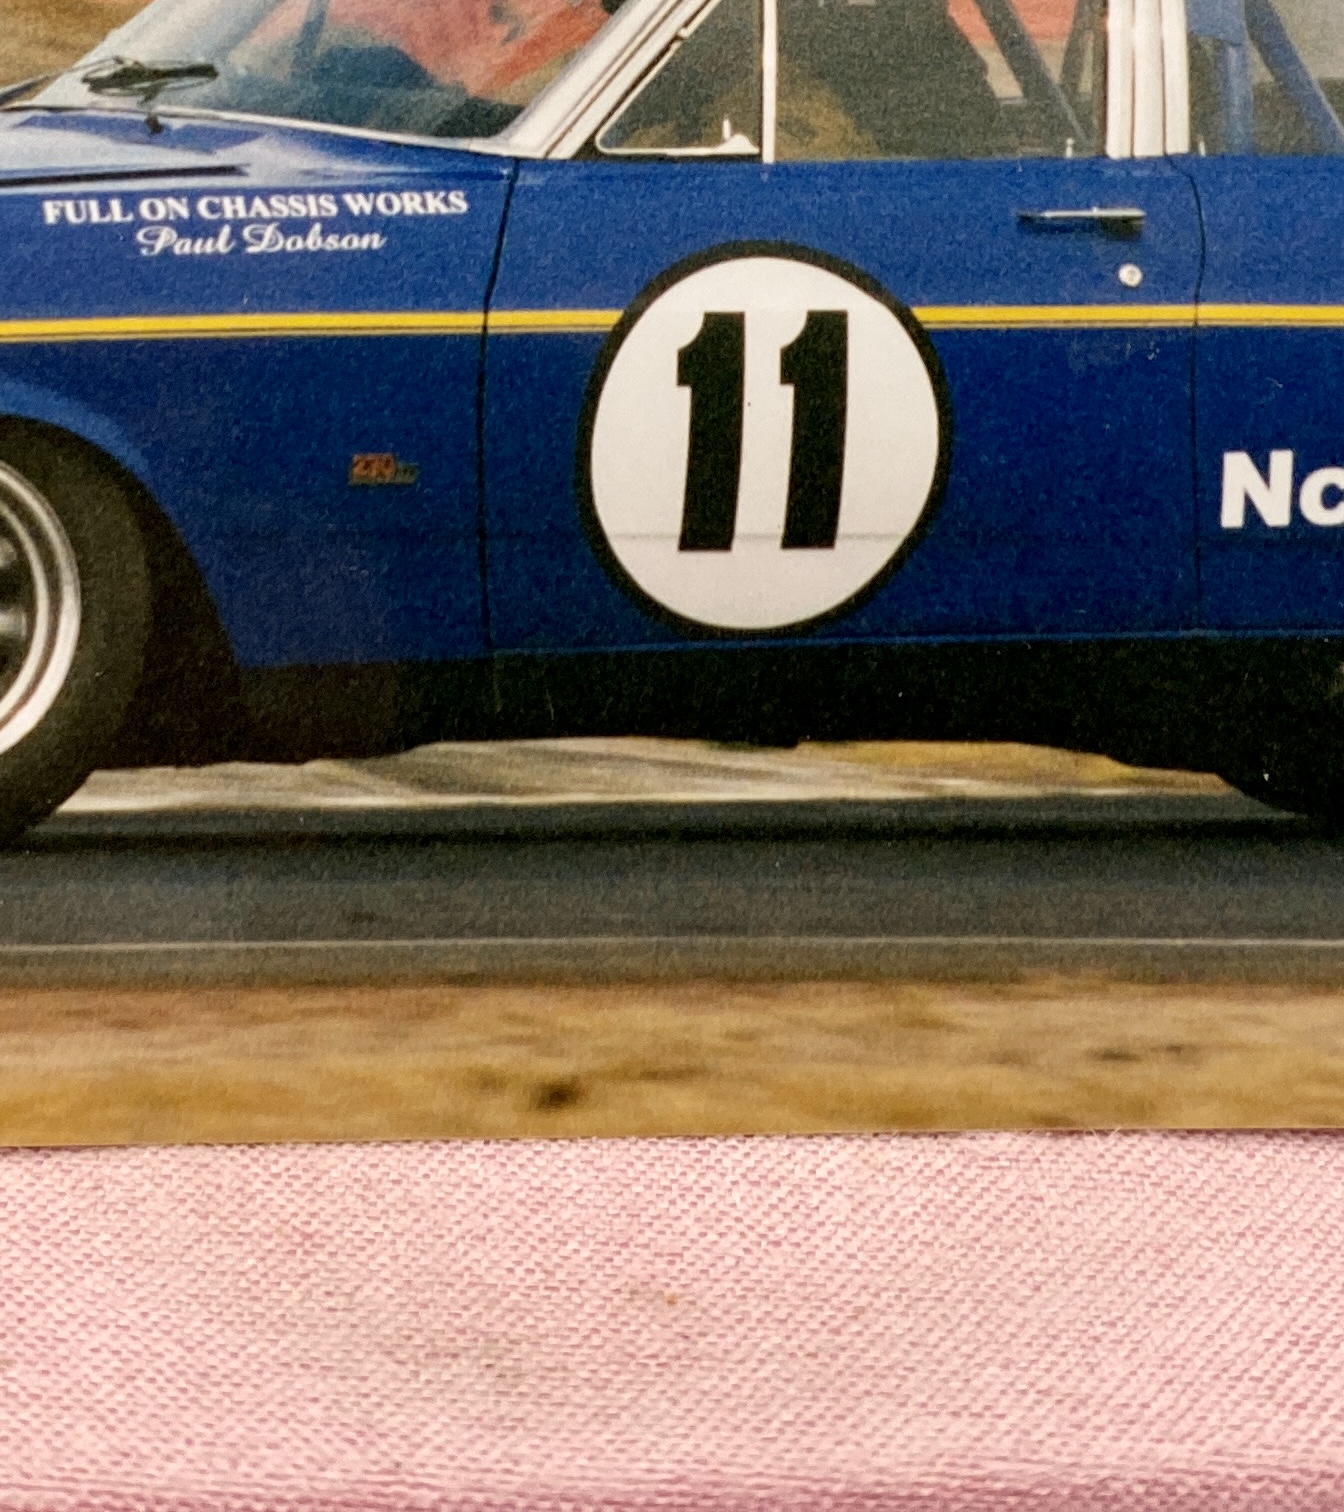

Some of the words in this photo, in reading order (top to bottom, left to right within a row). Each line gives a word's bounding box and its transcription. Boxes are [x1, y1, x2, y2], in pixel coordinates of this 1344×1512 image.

[43, 199, 135, 225] FULL
[140, 196, 192, 220] ON
[197, 193, 339, 220] CHASSIS
[344, 190, 469, 216] WORKS
[137, 225, 236, 256] Paul
[242, 222, 387, 254] Dobson
[676, 310, 849, 552] 11
